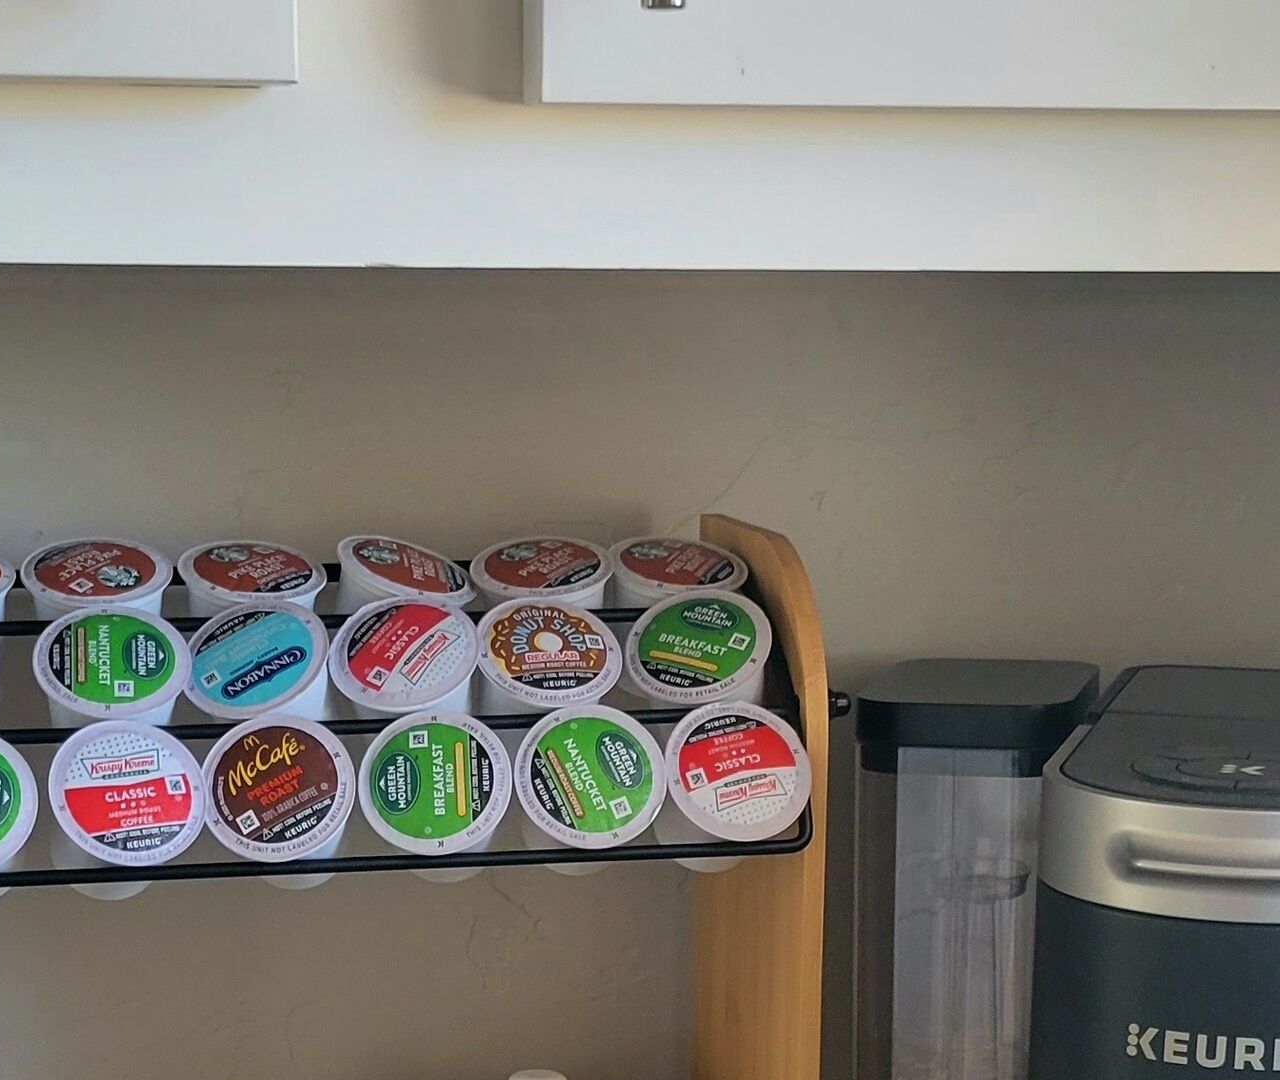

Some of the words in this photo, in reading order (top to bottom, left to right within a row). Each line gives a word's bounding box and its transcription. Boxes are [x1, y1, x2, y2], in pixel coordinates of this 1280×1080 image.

[228, 563, 255, 579] PIKE
[513, 609, 566, 620] ORIGINAL
[682, 611, 733, 627] MOUNTAIN
[694, 607, 728, 618] GREEN
[384, 626, 420, 660] CLASSIC
[510, 617, 545, 654] DONUT
[551, 620, 587, 651] SHOP
[659, 633, 728, 656] BREAKFAST
[88, 640, 97, 663] BLEND
[99, 624, 110, 686] NANTUCKET
[137, 635, 147, 676] MOUNTAIN
[147, 640, 156, 669] GREEN
[526, 652, 579, 662] REGULAR
[673, 646, 702, 658] BLEND
[227, 651, 302, 696] CINNABON
[543, 680, 577, 688] KEURIG
[660, 674, 693, 686] KEURIG
[651, 686, 678, 698] LABELED
[695, 687, 719, 696] RETAIL
[720, 678, 736, 690] SALE
[704, 717, 736, 730] KEURIG
[714, 733, 744, 745] COFFEE
[90, 759, 123, 777] Krispy
[123, 755, 156, 770] Kreme
[228, 732, 300, 796] McCafé
[602, 736, 632, 787] MOUNTAIN
[614, 741, 636, 775] GREEN
[714, 754, 761, 773] CLASSIC
[247, 765, 304, 801] PREMIUM
[387, 765, 397, 801] GREEN
[396, 756, 407, 808] MOUNTAIN
[432, 743, 445, 816] BREAKFAST
[445, 763, 455, 793] BLEND
[481, 757, 490, 792] KEURIG
[564, 738, 607, 812] NANTUCKET
[565, 762, 584, 792] BLEND
[105, 787, 157, 802] CLASSIC
[260, 779, 300, 807] ROAST
[276, 796, 299, 814] ARABICA
[299, 787, 318, 802] COFFEE
[533, 778, 554, 810] KEURIG
[121, 815, 154, 827] COFFEE
[284, 815, 319, 839] KEURIG
[545, 820, 566, 837] RETAIL
[126, 837, 162, 849] KEURIG
[235, 838, 250, 850] THIS
[252, 845, 269, 854] UNIT
[271, 846, 286, 854] NOT
[287, 833, 318, 852] LABELED
[318, 822, 331, 835] FOR
